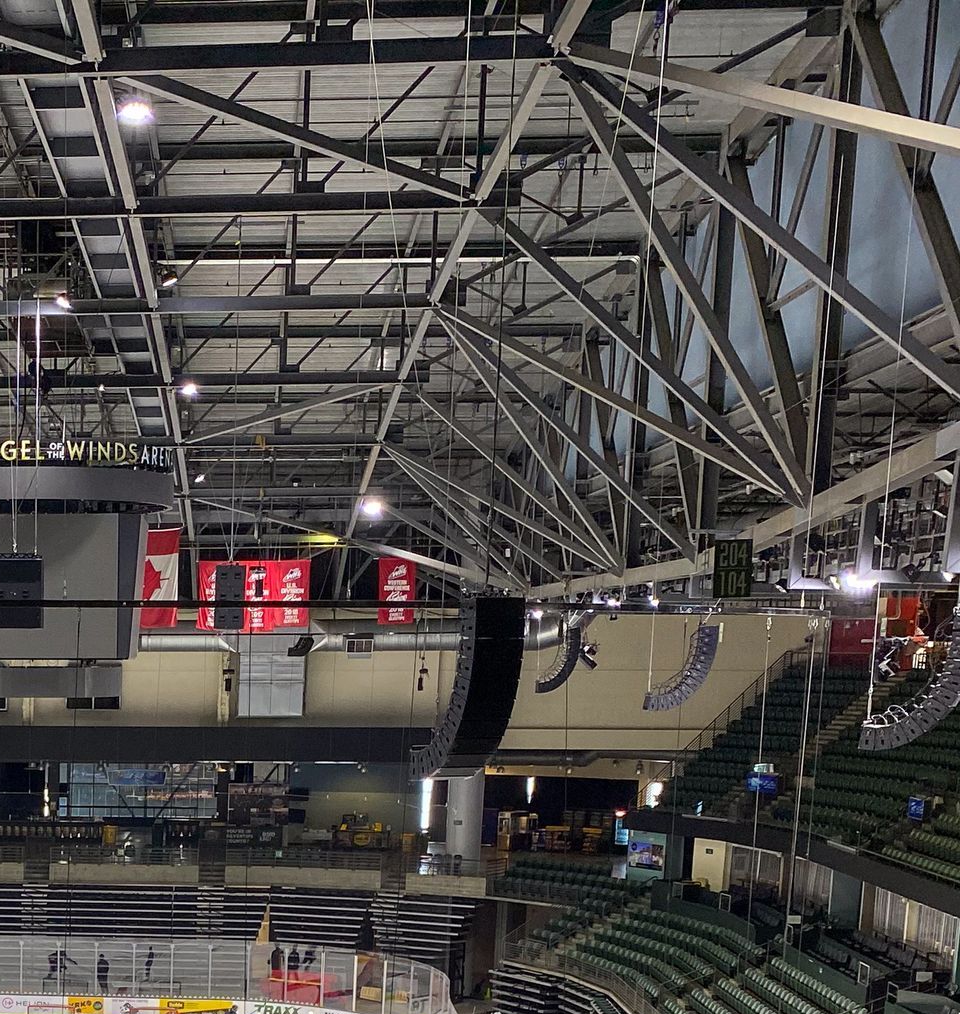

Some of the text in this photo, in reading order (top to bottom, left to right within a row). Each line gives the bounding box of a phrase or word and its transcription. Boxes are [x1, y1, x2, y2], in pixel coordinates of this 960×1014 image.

[47, 450, 64, 461] THE
[49, 441, 62, 450] OF
[66, 440, 139, 463] WINDS
[140, 443, 174, 467] AREN
[720, 542, 748, 566] 204
[720, 571, 747, 595] 104
